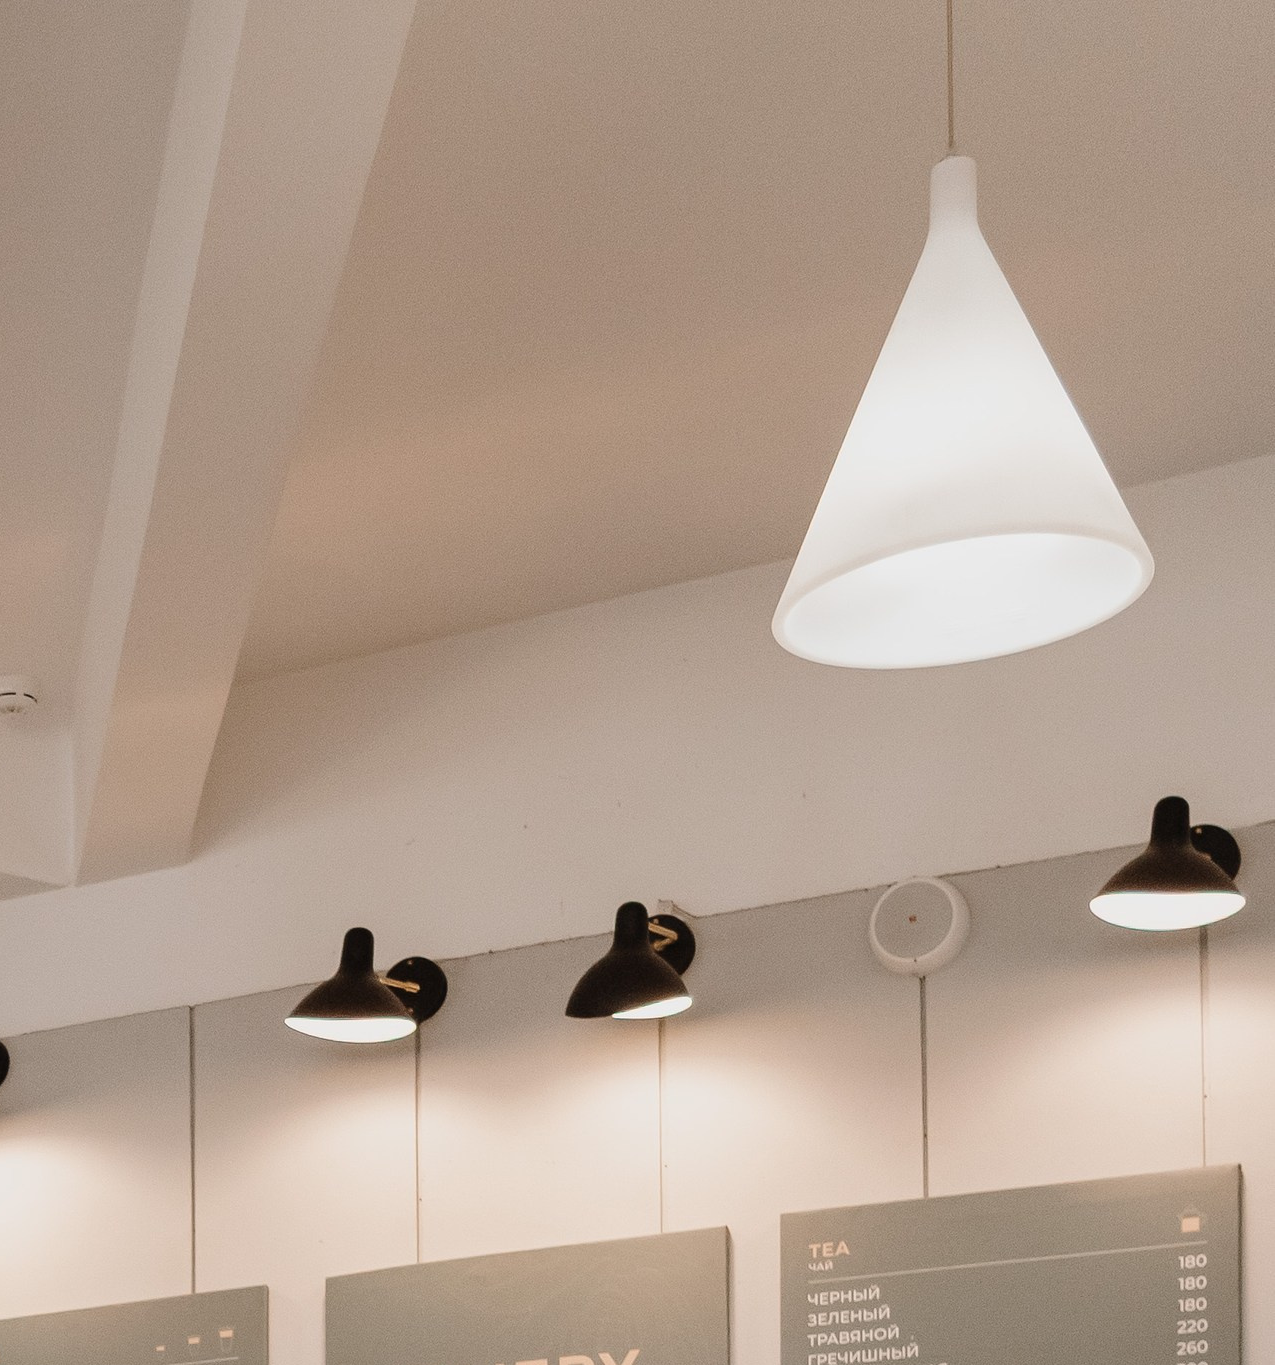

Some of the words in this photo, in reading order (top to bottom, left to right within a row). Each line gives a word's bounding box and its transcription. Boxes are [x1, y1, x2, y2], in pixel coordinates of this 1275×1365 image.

[809, 1241, 850, 1259] TEA
[808, 1260, 833, 1271] ЧАЙ
[807, 1284, 880, 1306] ЧЕРНЫЙ
[1178, 1253, 1208, 1269] 180
[807, 1304, 890, 1327] ЗЕЛЕНЫЙ
[1178, 1275, 1208, 1291] 180
[807, 1324, 900, 1347] ТРАВЯНОЙ
[1178, 1296, 1208, 1312] 180
[1177, 1318, 1208, 1334] 220
[1176, 1339, 1208, 1356] 260
